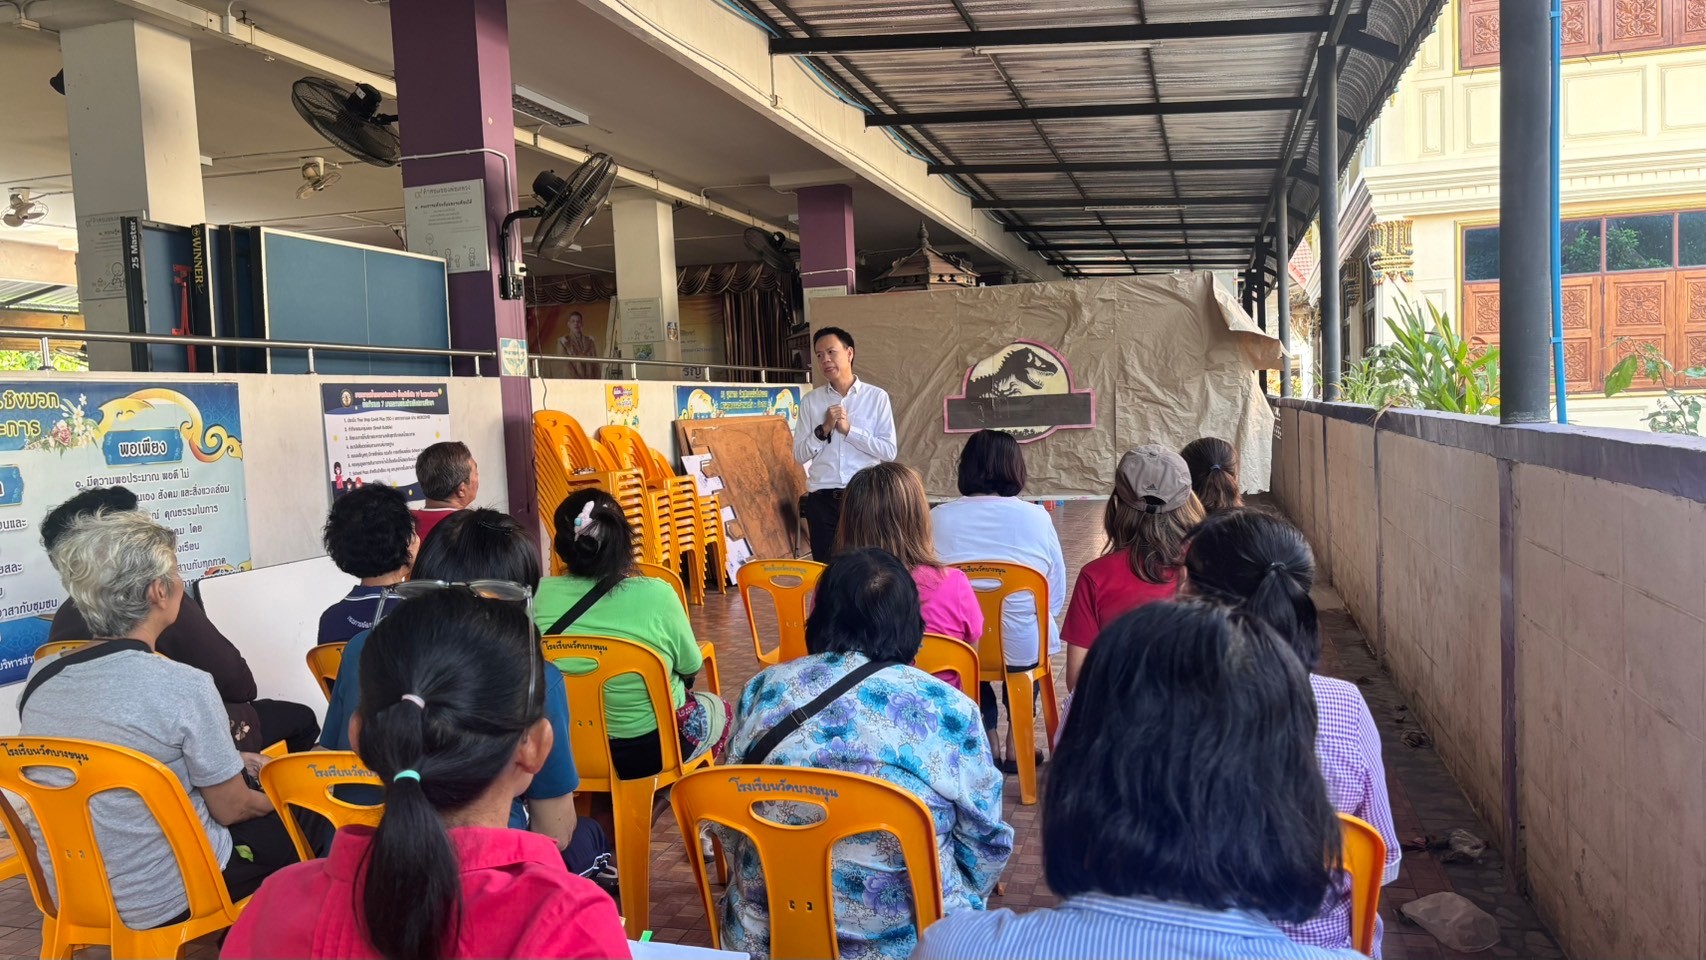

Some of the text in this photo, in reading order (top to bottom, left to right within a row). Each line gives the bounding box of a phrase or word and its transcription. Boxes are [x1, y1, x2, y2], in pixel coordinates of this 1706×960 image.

[130, 220, 139, 269] 25 Master
[192, 236, 204, 284] WINNER
[0, 390, 59, 409] ชิงบวก
[119, 437, 167, 456] พอเพียง
[0, 742, 89, 766] โรงเรียนวัดบางขนุน
[728, 777, 839, 802] โรงเรียนวัดบางขนุน
